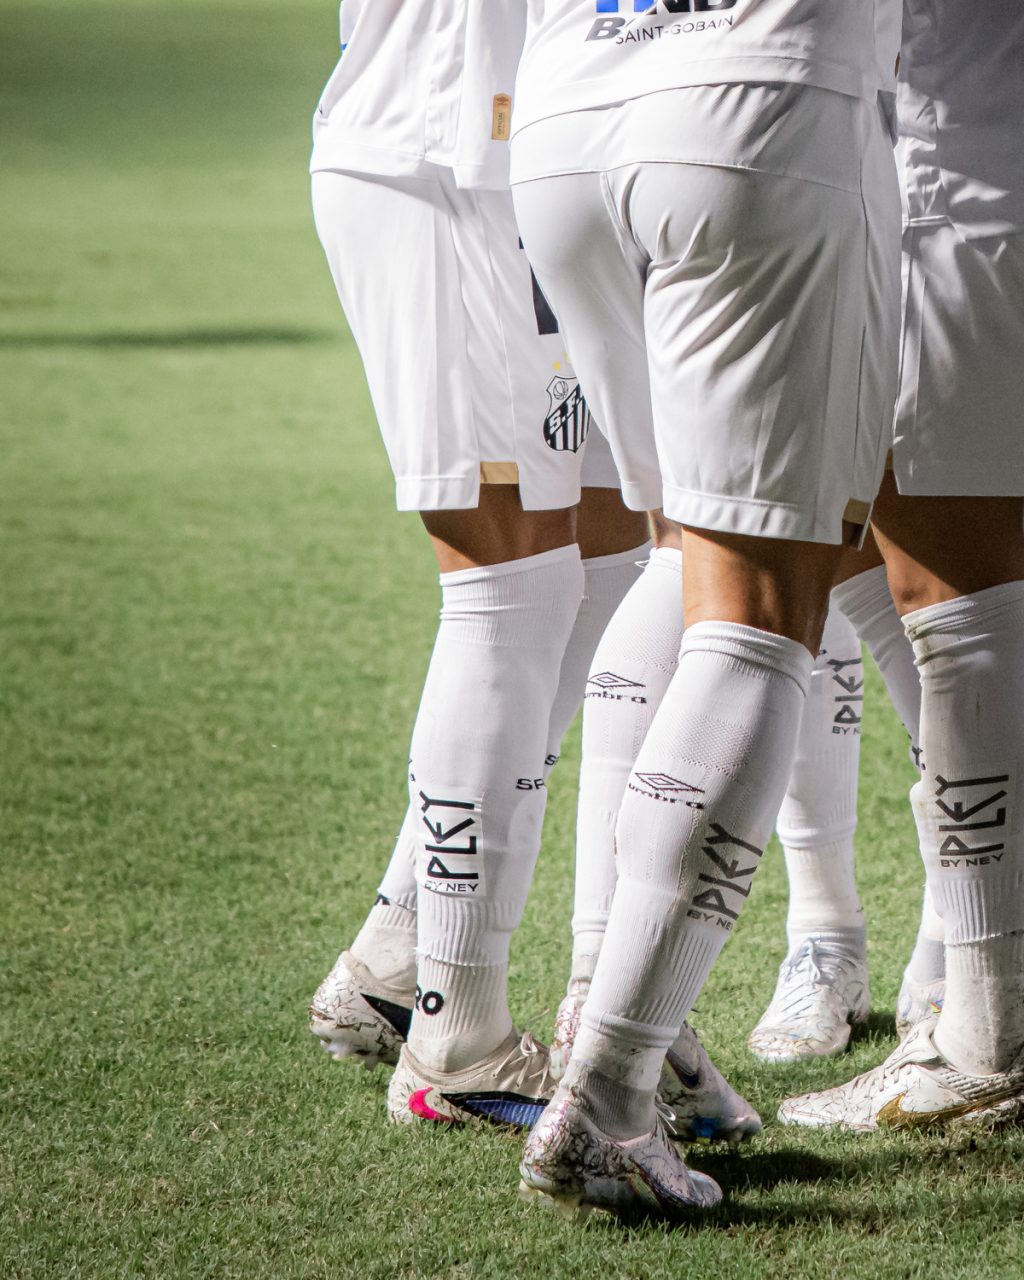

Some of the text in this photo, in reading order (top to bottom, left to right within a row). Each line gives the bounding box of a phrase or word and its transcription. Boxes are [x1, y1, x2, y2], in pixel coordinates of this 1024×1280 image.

[941, 853, 1004, 868] BY NEY
[446, 883, 479, 892] NEY
